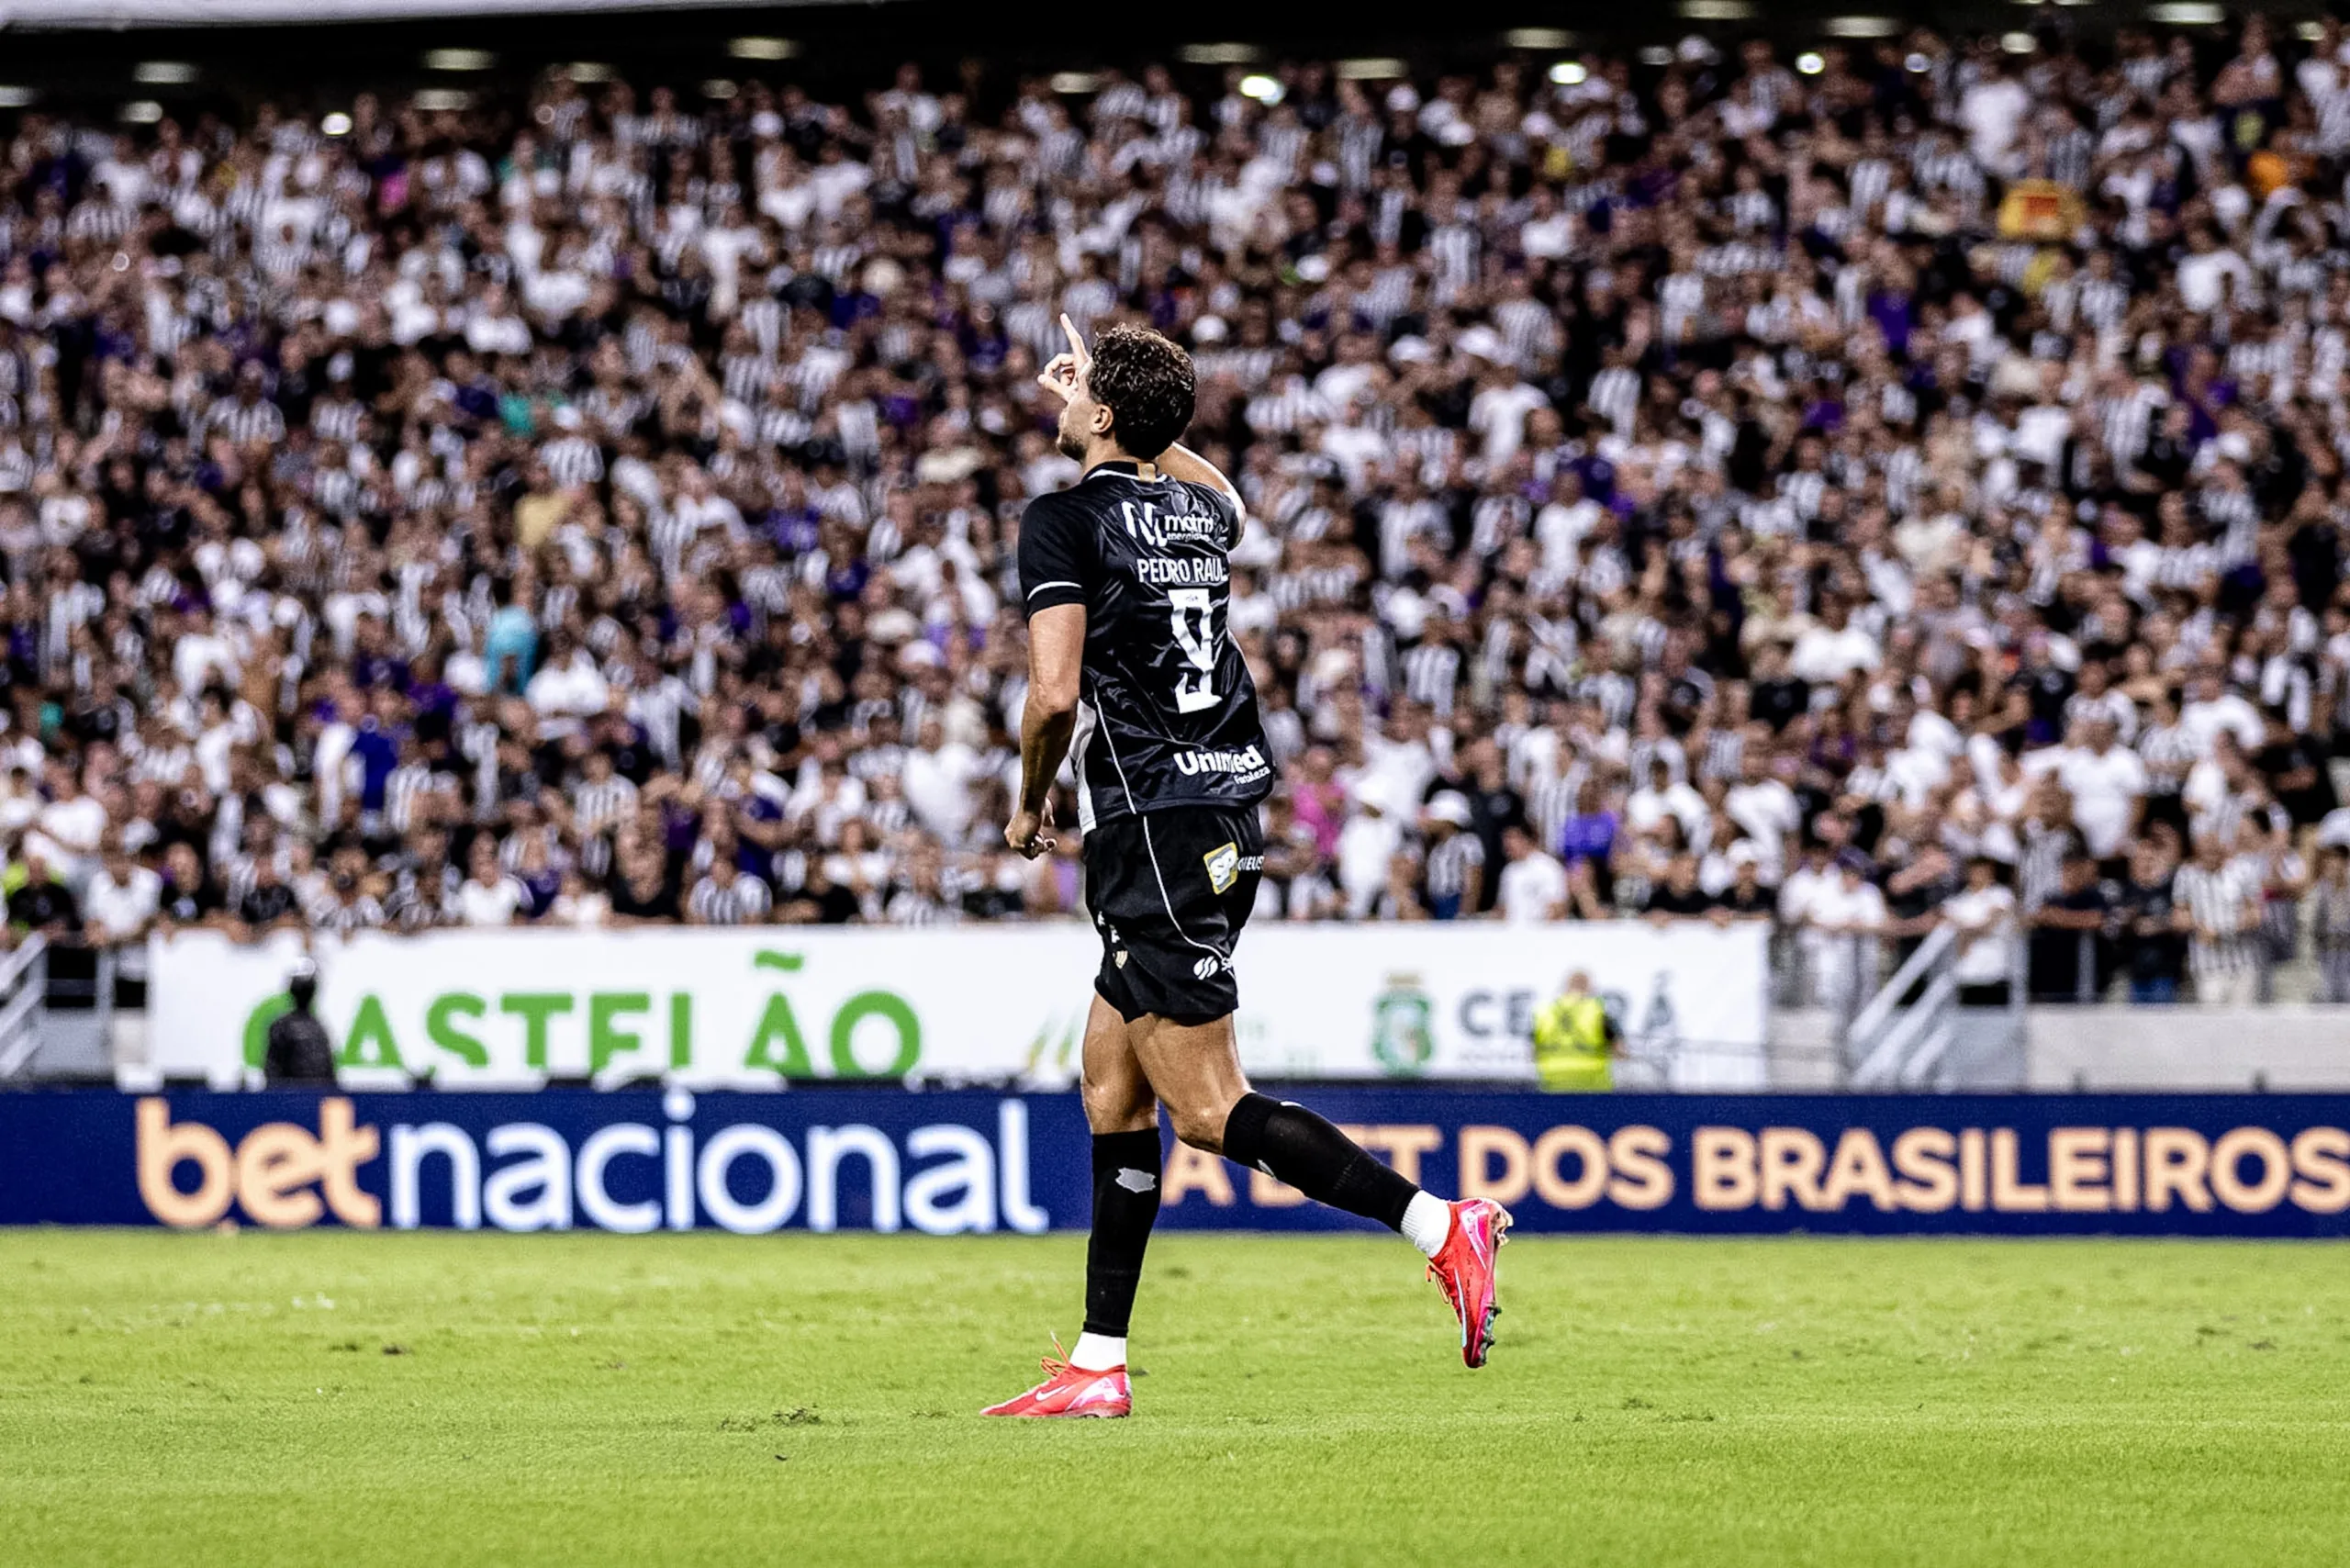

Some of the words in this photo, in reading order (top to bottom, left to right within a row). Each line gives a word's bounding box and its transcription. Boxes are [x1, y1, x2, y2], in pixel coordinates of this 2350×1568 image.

[1137, 558, 1191, 583] PEDRO
[1167, 588, 1223, 714] 9
[1173, 745, 1266, 776] Unimed
[1458, 1124, 1675, 1211] DOS
[1692, 1126, 2350, 1214] BRASILEIROS
